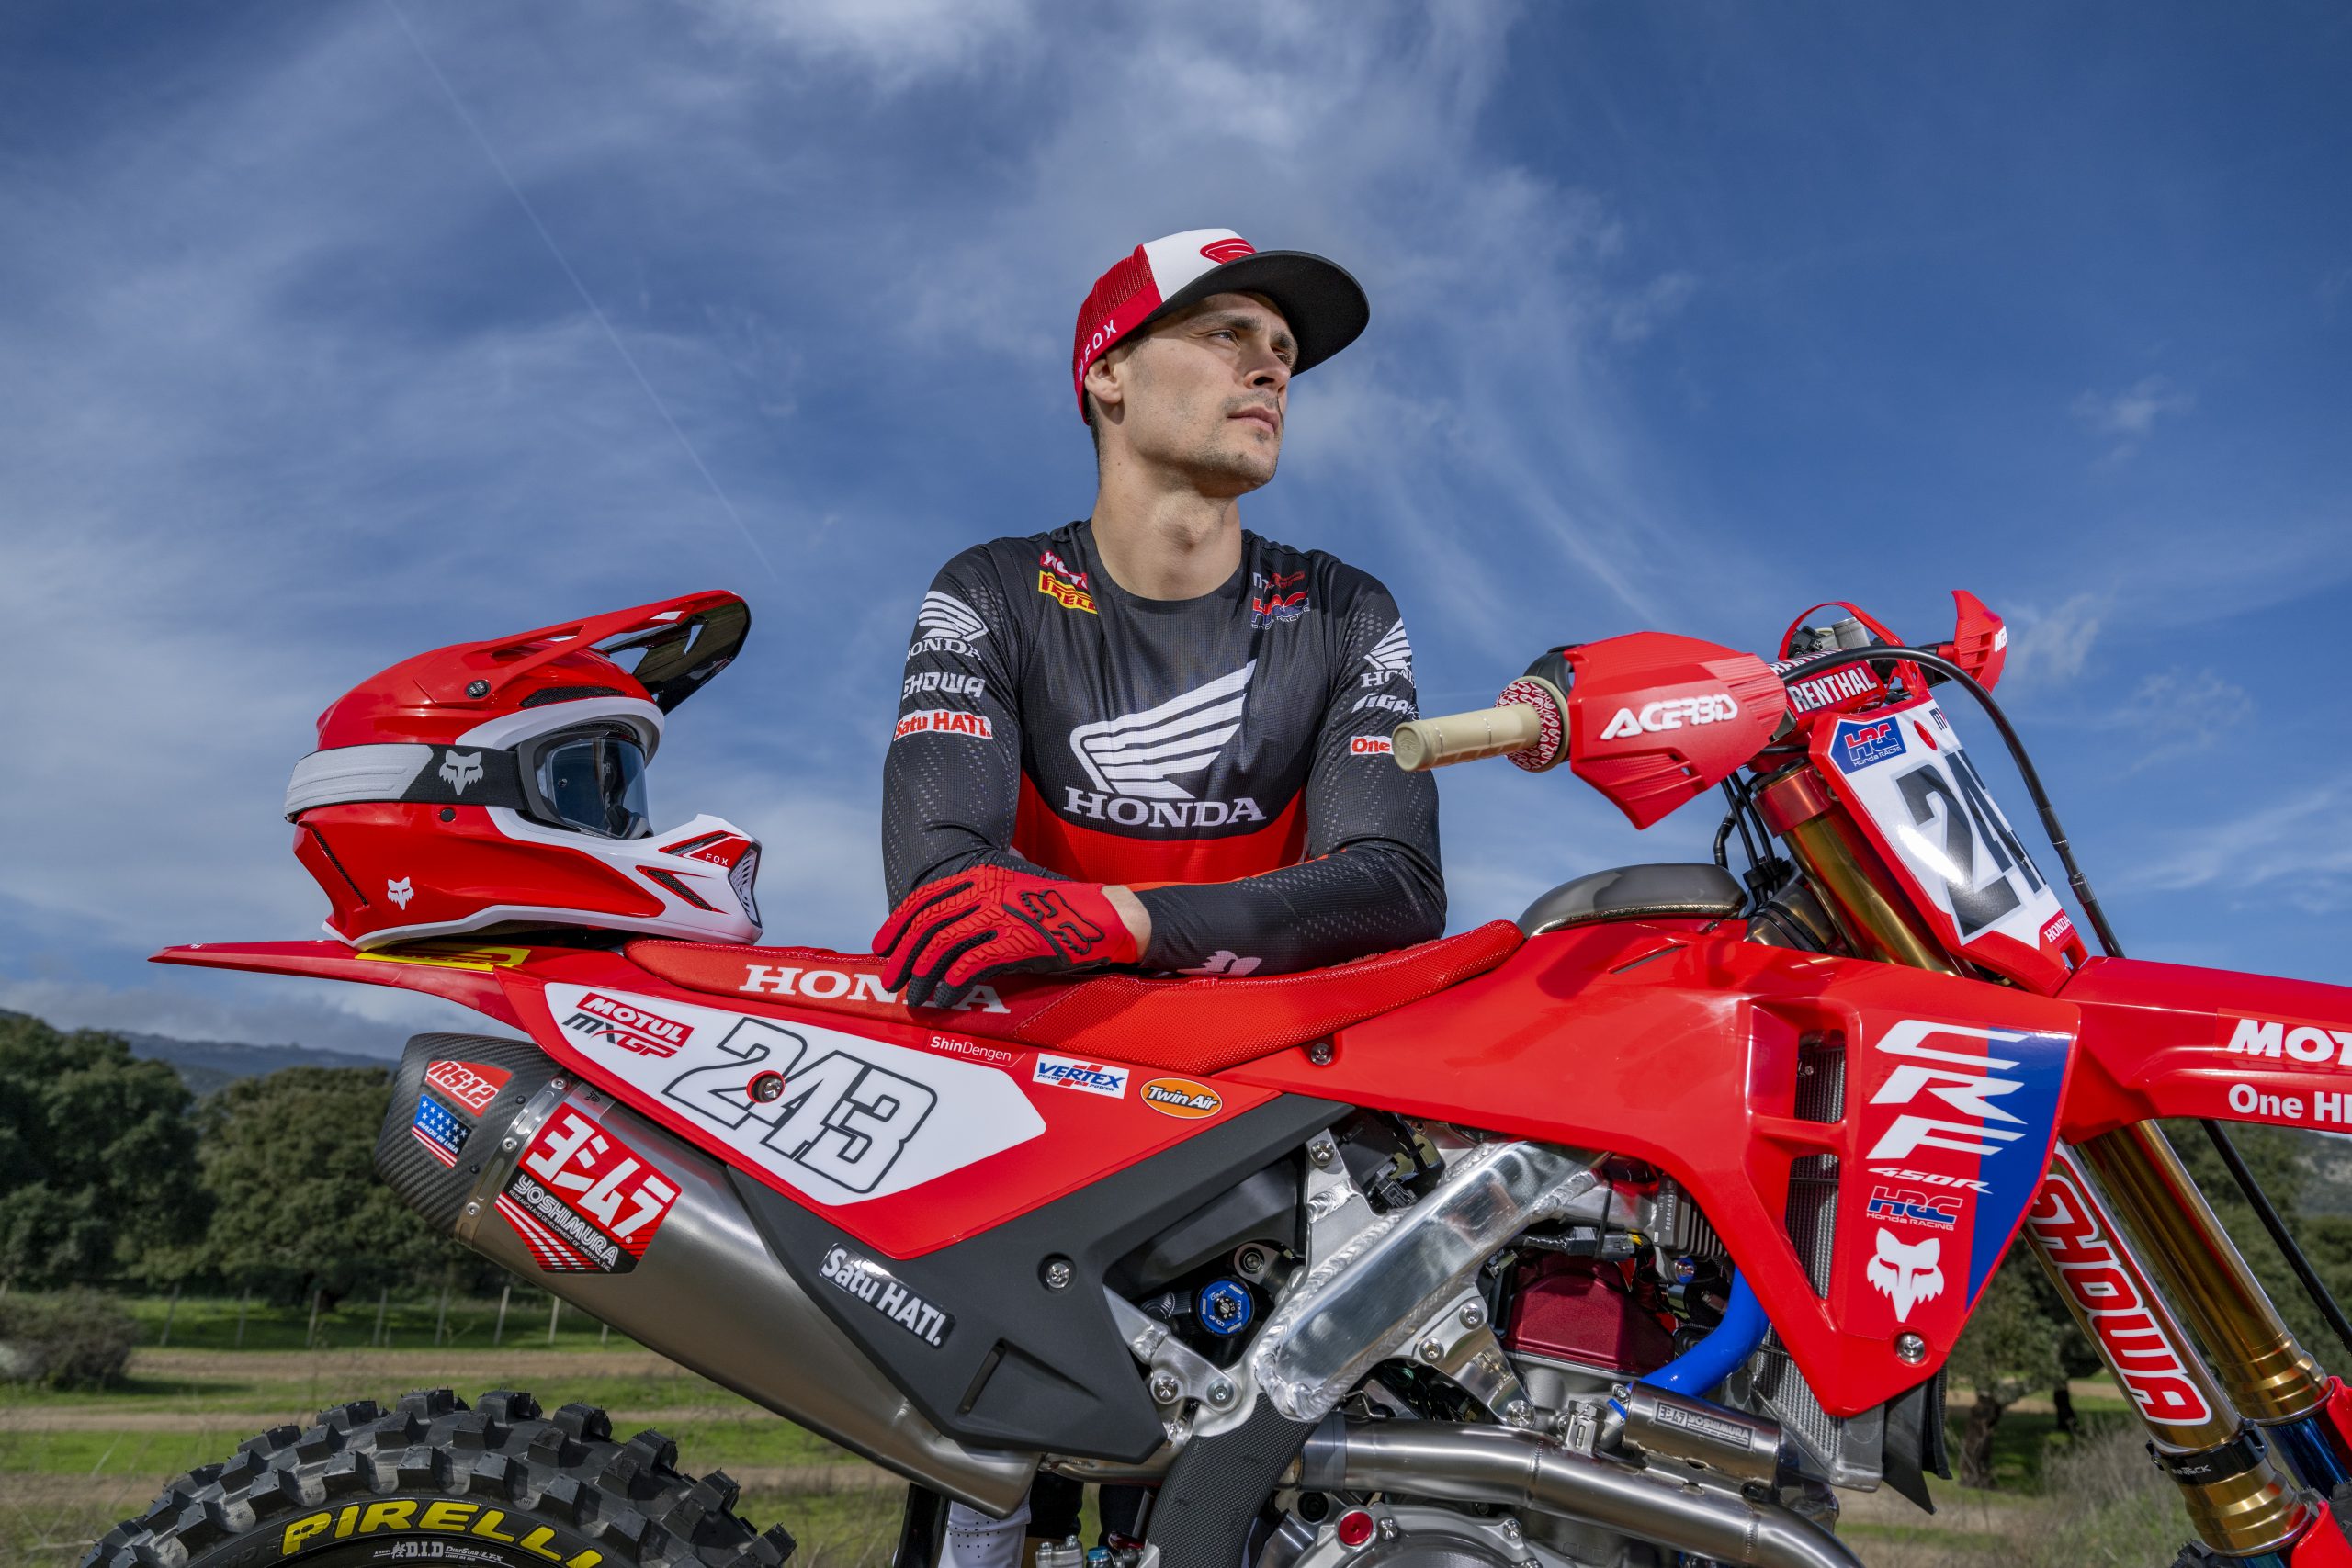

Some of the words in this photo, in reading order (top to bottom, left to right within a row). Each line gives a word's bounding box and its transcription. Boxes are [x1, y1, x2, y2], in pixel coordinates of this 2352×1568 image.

[1085, 319, 1117, 364] FOX
[902, 671, 986, 702] SHOWA
[1786, 666, 1878, 713] RENTHAL
[897, 716, 928, 739] Satu
[1351, 738, 1390, 753] One
[1844, 722, 1899, 761] HRC
[1853, 753, 1880, 766] Honda
[1879, 746, 1903, 759] RACING
[1064, 786, 1266, 828] HONDA
[706, 852, 729, 866] FOX
[1895, 749, 2046, 938] 24
[2043, 914, 2072, 943] HONDA
[738, 964, 1012, 1013] HONA
[561, 1012, 678, 1058] MXGP
[584, 998, 684, 1043] MOTUL
[930, 1036, 1012, 1062] ShinDengen
[1038, 1062, 1125, 1089] VERTEX
[1089, 1083, 1115, 1091] POWER
[1865, 1020, 2028, 1160] CRF
[662, 1017, 937, 1193] 243
[1148, 1085, 1189, 1106] Twin
[1189, 1096, 1218, 1110] Air
[2228, 1083, 2304, 1119] One
[417, 1121, 438, 1138] MADE
[436, 1134, 445, 1144] IN
[443, 1139, 459, 1154] USA
[526, 1112, 676, 1238] ヨシムラ
[1868, 1167, 1994, 1195] 450R
[508, 1189, 534, 1211] RESEARCH
[531, 1207, 543, 1219] AND
[540, 1213, 574, 1244] DEVELOPMENT
[571, 1239, 581, 1248] OF
[513, 1174, 619, 1267] YOSHIMURA
[1866, 1212, 1908, 1224] Honda
[1909, 1218, 1954, 1231] RACING
[1867, 1186, 1963, 1224] HRC
[821, 1248, 881, 1303] Satu
[876, 1282, 947, 1347] HATI.
[2031, 1174, 2211, 1425] SHOWA
[1688, 1414, 1749, 1438] YOSHIMURA
[405, 1541, 444, 1558] D.I.D
